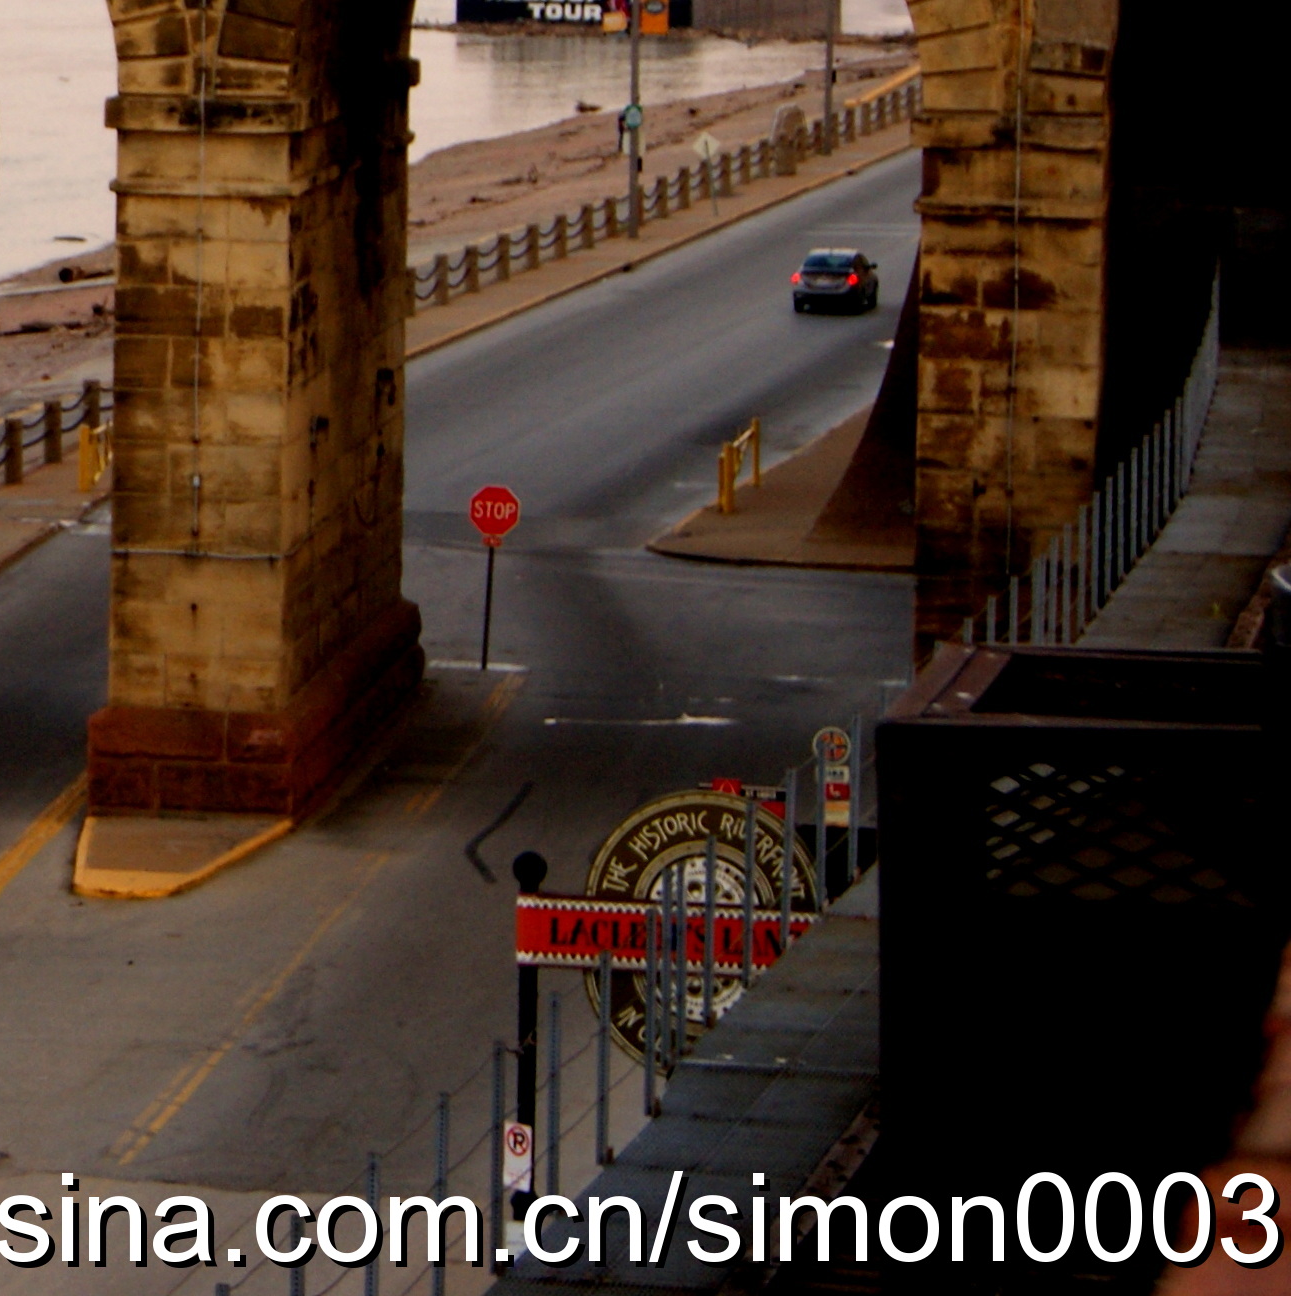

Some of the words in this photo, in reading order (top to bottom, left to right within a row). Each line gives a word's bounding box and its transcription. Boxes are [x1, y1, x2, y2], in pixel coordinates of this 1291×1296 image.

[528, 3, 603, 21] TOUR
[474, 500, 516, 520] STOP
[602, 856, 638, 893] THE
[628, 810, 710, 861] HISTORIC
